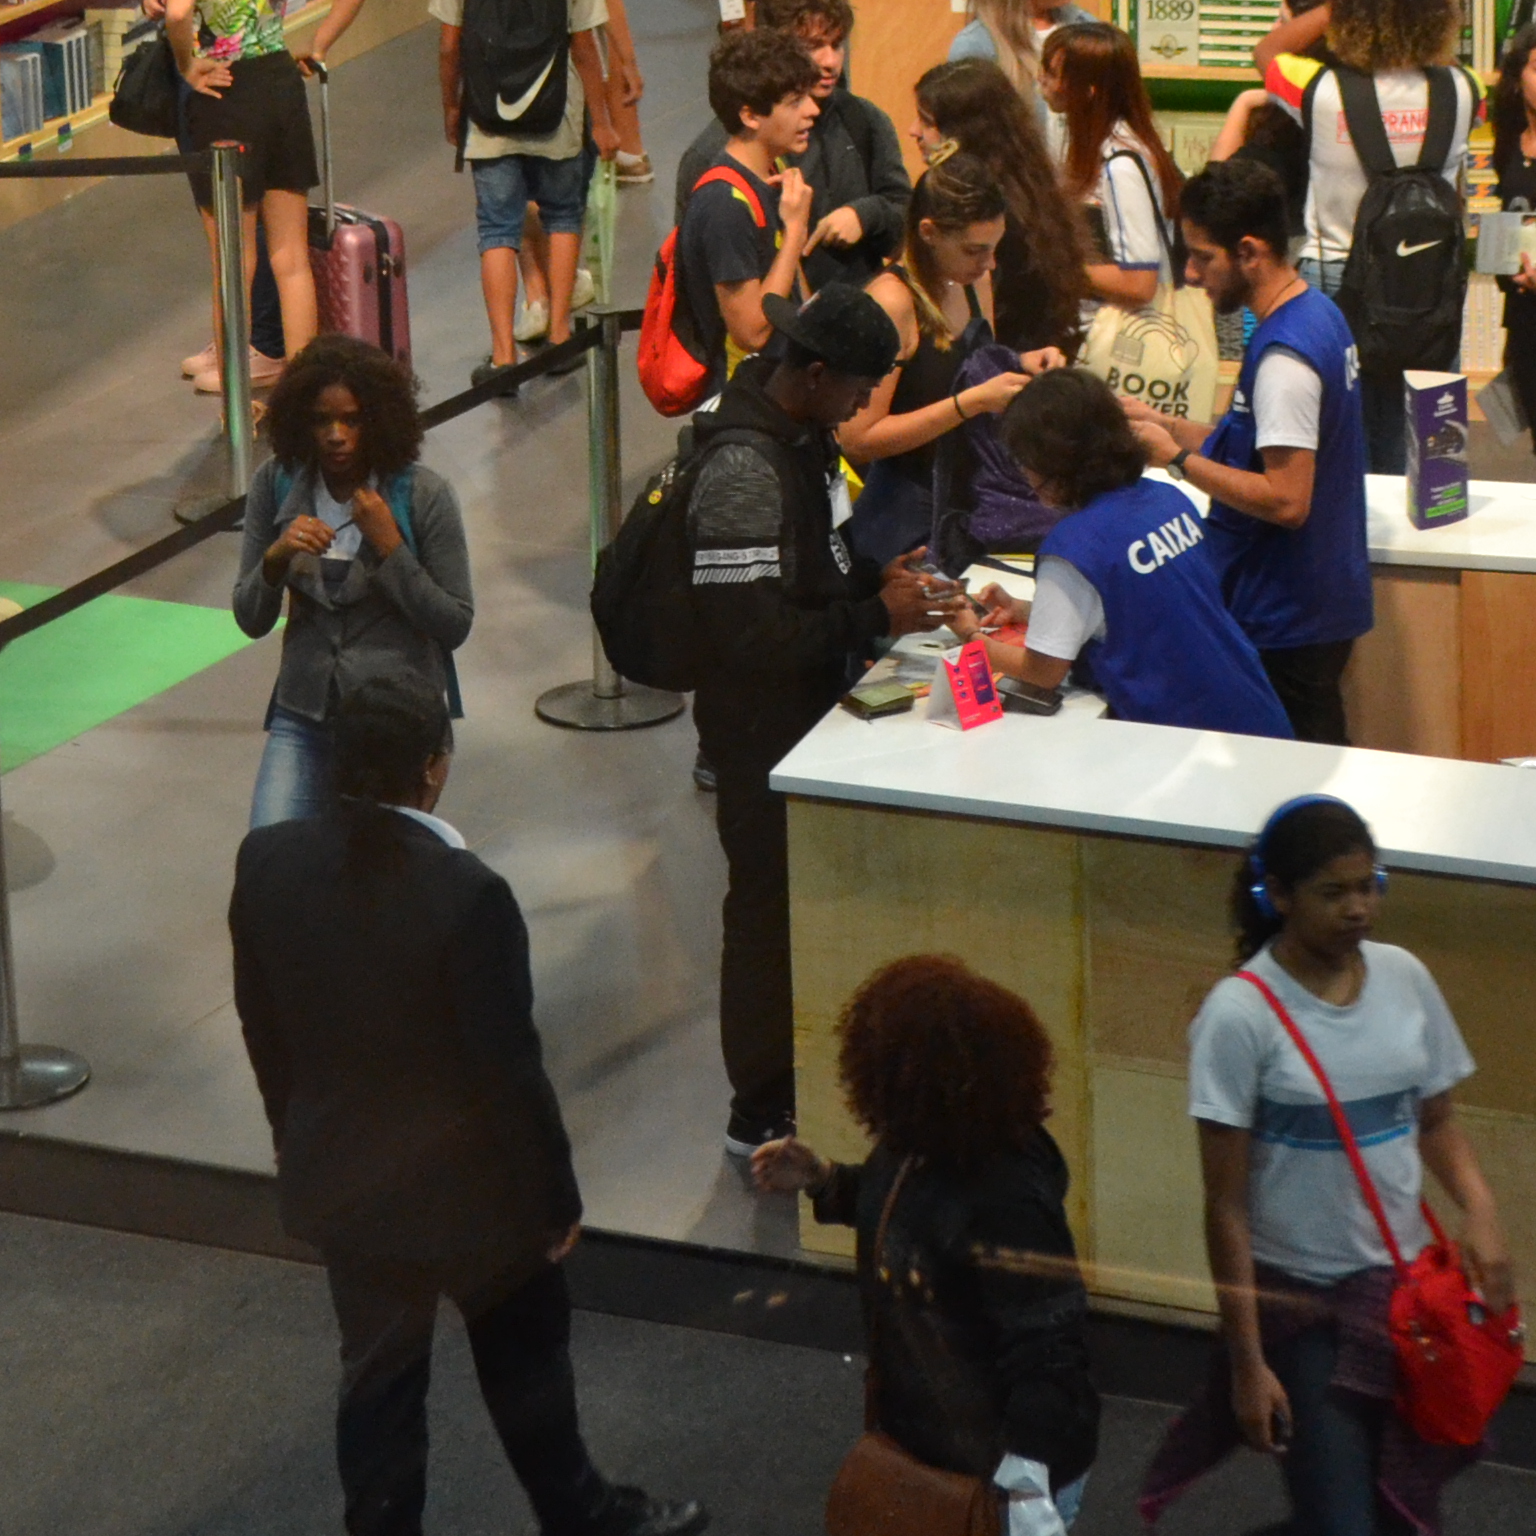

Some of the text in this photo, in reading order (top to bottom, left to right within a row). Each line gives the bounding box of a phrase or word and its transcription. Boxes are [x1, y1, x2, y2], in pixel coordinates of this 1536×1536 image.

[1146, 0, 1194, 21] 1889
[1107, 366, 1189, 402] BOOK
[1127, 513, 1204, 575] CAIXA
